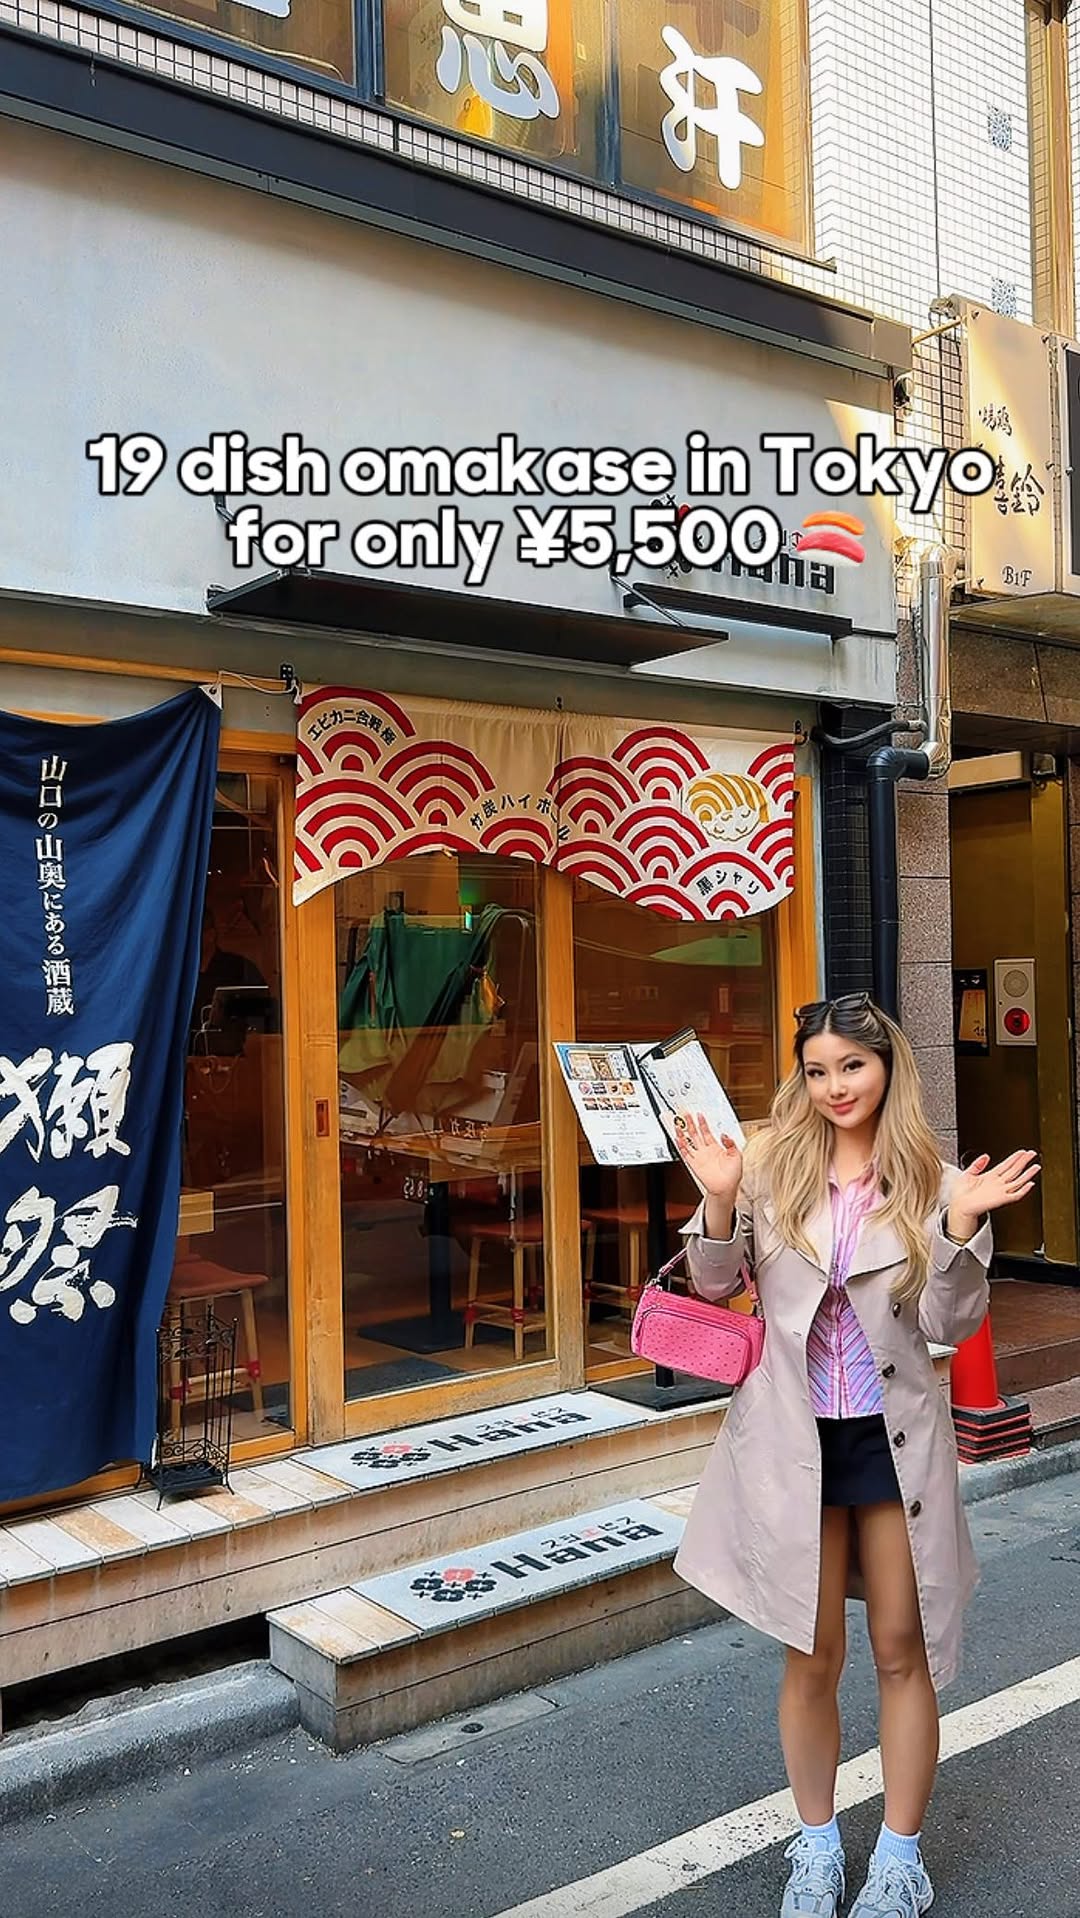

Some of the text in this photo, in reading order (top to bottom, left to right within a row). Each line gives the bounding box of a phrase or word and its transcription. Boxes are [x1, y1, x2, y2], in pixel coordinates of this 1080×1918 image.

[1002, 564, 1033, 588] B1F
[469, 794, 571, 841] 竹炭ハイボール
[34, 755, 76, 1017] 山口の山奥にある酒蔵
[695, 869, 760, 896] 黒シャリ
[428, 1412, 592, 1453] Hana
[490, 1523, 664, 1580] Hana
